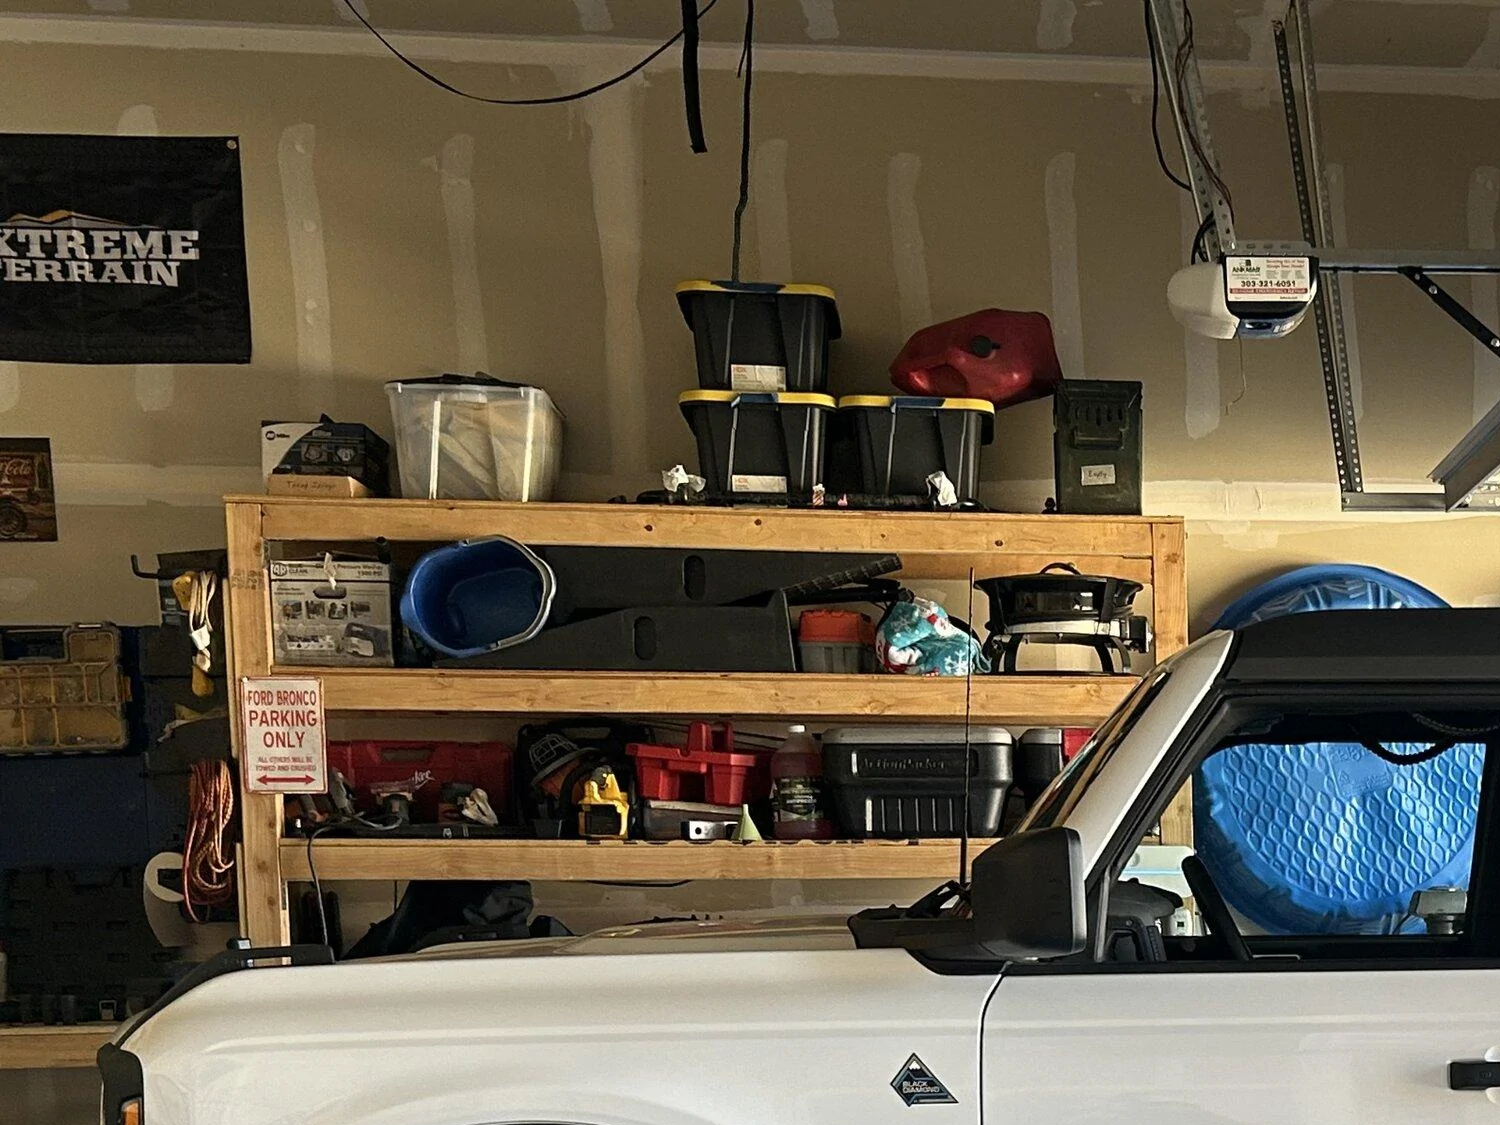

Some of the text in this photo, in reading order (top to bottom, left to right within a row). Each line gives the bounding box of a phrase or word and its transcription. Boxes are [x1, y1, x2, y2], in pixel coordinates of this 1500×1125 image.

[0, 229, 200, 261] XTREME
[0, 258, 181, 288] ERRAIN
[247, 690, 317, 706] FORD BRONCO
[249, 710, 317, 727] PARKING
[263, 731, 305, 748] ONLY
[269, 756, 291, 764] OTHERS
